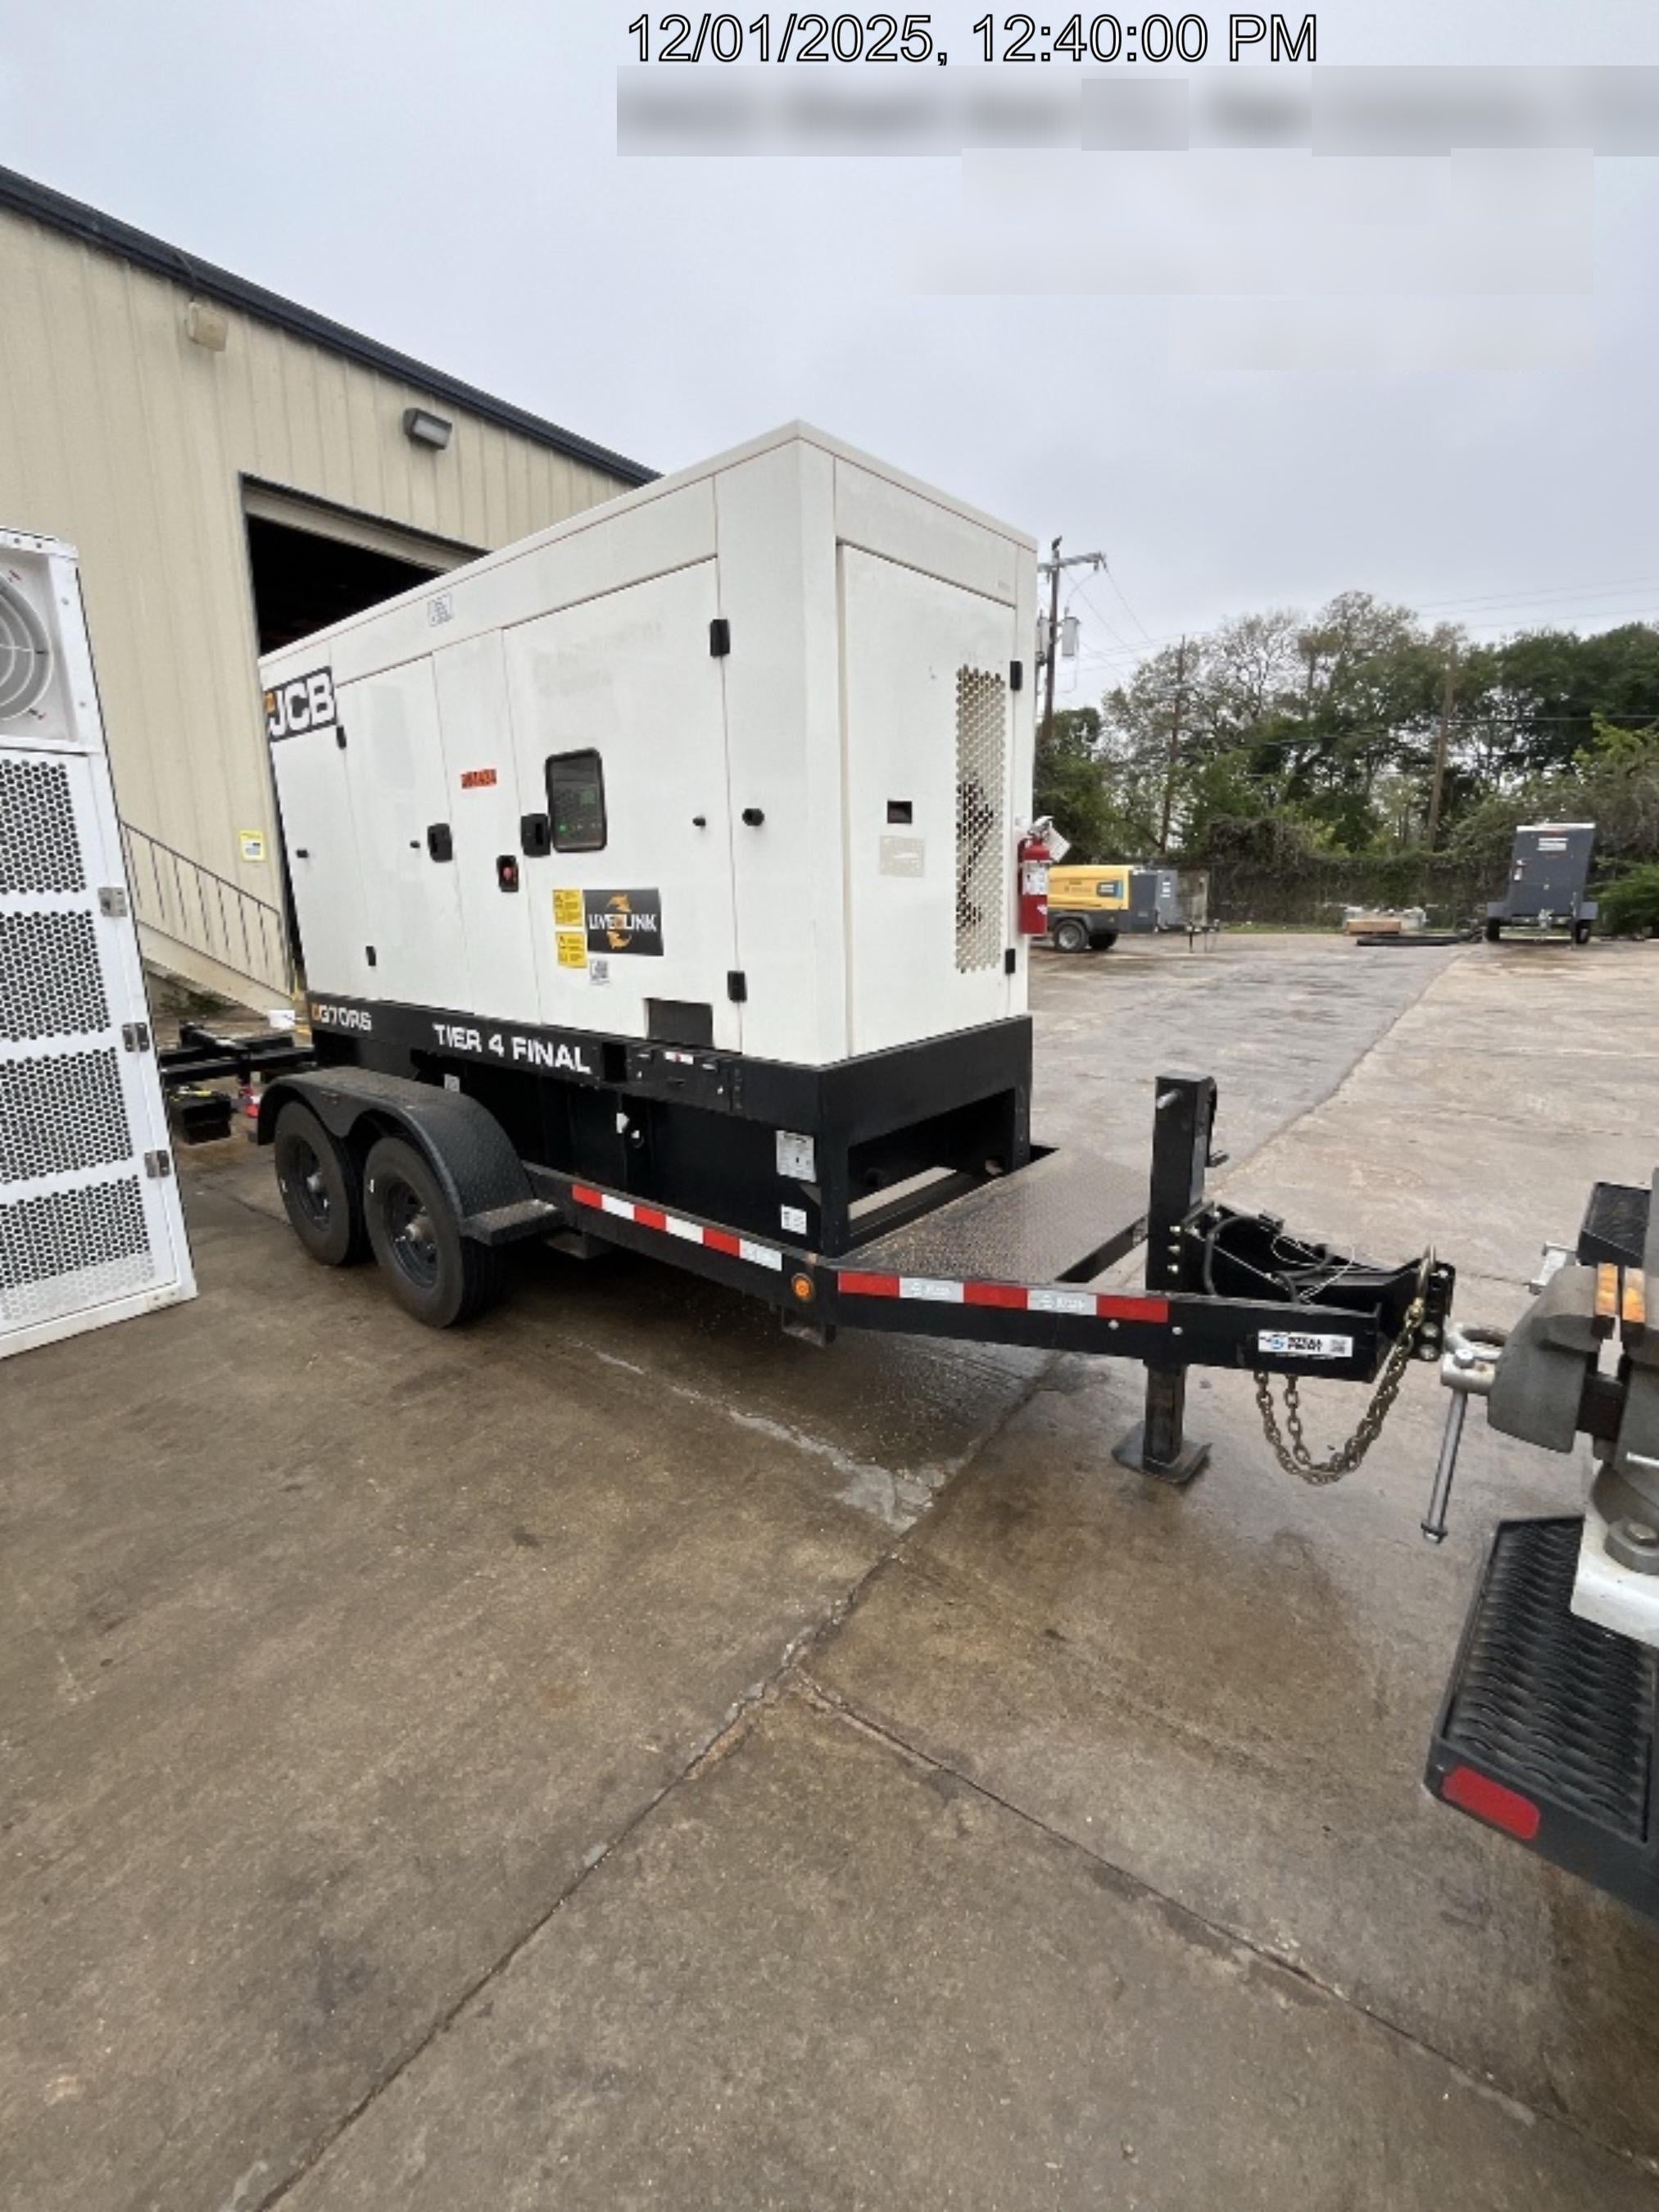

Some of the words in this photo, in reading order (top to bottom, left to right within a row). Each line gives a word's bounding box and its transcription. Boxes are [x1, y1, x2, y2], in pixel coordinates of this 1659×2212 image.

[268, 673, 335, 736] JCB
[433, 1022, 482, 1053] TIER
[488, 1033, 505, 1058] 4
[511, 1036, 592, 1074] FINAL
